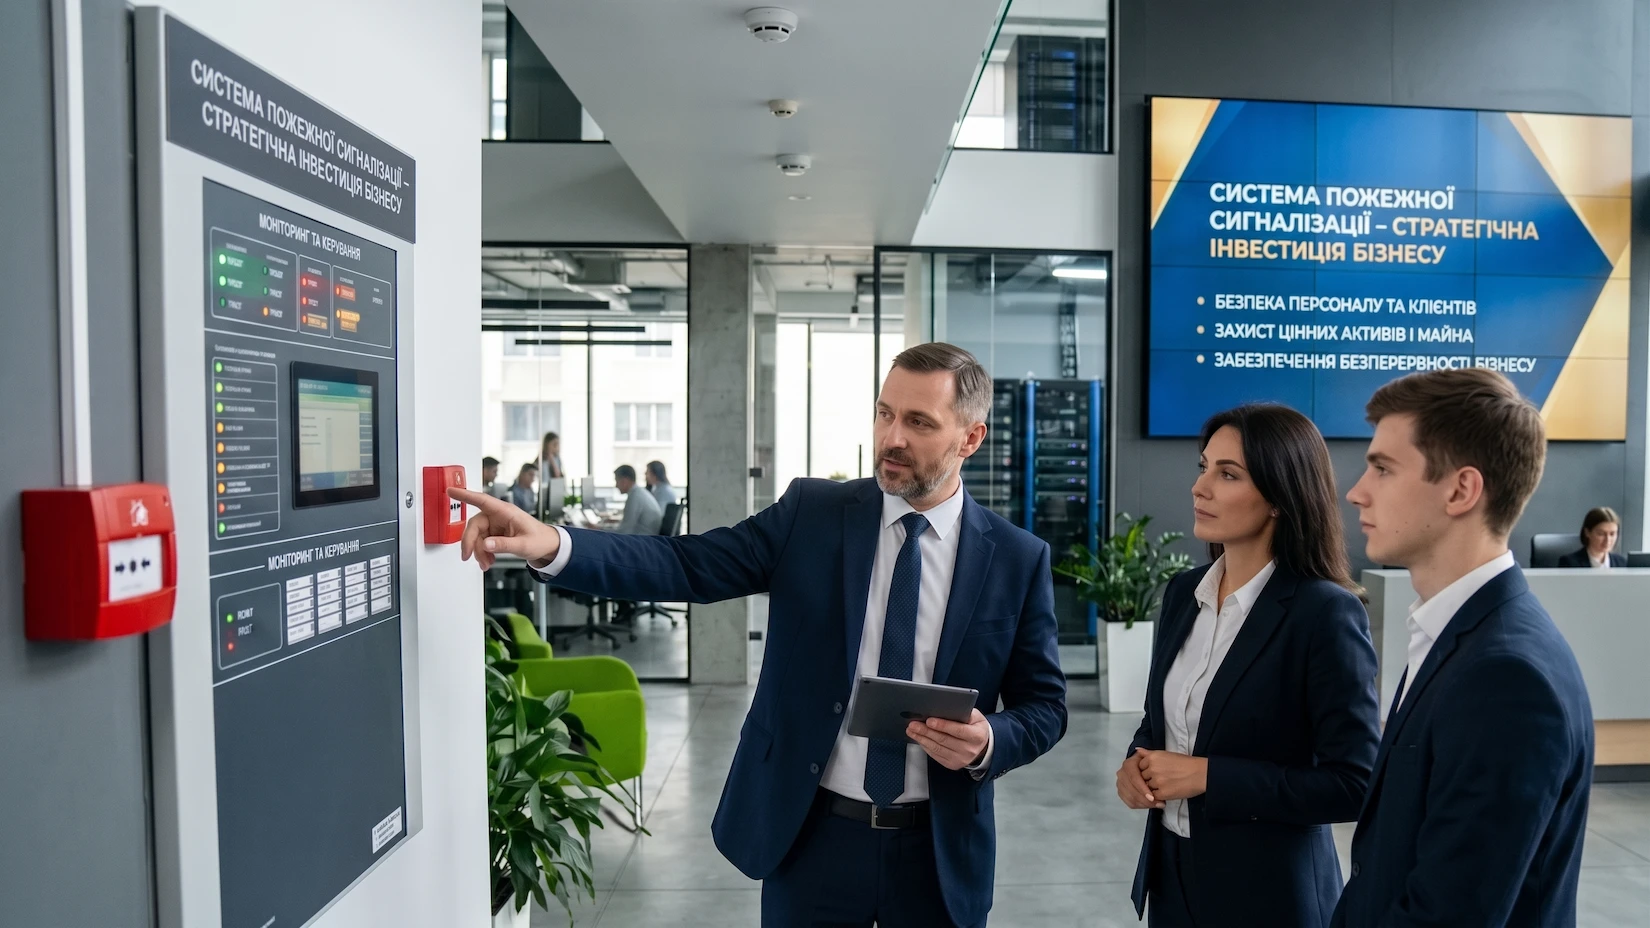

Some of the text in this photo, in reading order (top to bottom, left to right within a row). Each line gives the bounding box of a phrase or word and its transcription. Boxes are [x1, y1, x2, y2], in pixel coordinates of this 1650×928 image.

[191, 59, 264, 118] СИСТЕМА
[268, 100, 335, 154] ПОЖЕЖНОЇ
[337, 139, 402, 188] СИГНАЛІЗАЦІЇ
[202, 101, 402, 214] СТРАТЕГІЧНА ІНВЕСТИЦІЯ БІЗНЕСУ
[1210, 182, 1455, 210] СИСТЕМА ПОЖЕЖНОЇ
[259, 213, 361, 260] МОНІТОРИНГ ТА КЕРУВАННЯ
[1210, 210, 1371, 237] СИГНАЛІЗАЦІЇ
[1393, 217, 1538, 240] СТРАТЕГІЧНА
[1210, 238, 1446, 264] ІНВЕСТИЦІЯ БІЗНЕСУ
[1215, 294, 1476, 315] БЕЗПЕКА ПЕРСОНАЛУ ТА КЛІЄНТІВ
[1214, 323, 1474, 343] ЗАХИСТ ЦІННИХ АКТИВІВ І МАЙНА
[1214, 352, 1536, 373] ЗАБЕЗПЕЧЕННЯ БЕЗПЕРЕРВНОСТІ БІЗНЕСУ
[268, 549, 313, 571] МОНІТОРИНГ
[315, 548, 324, 560] ТА
